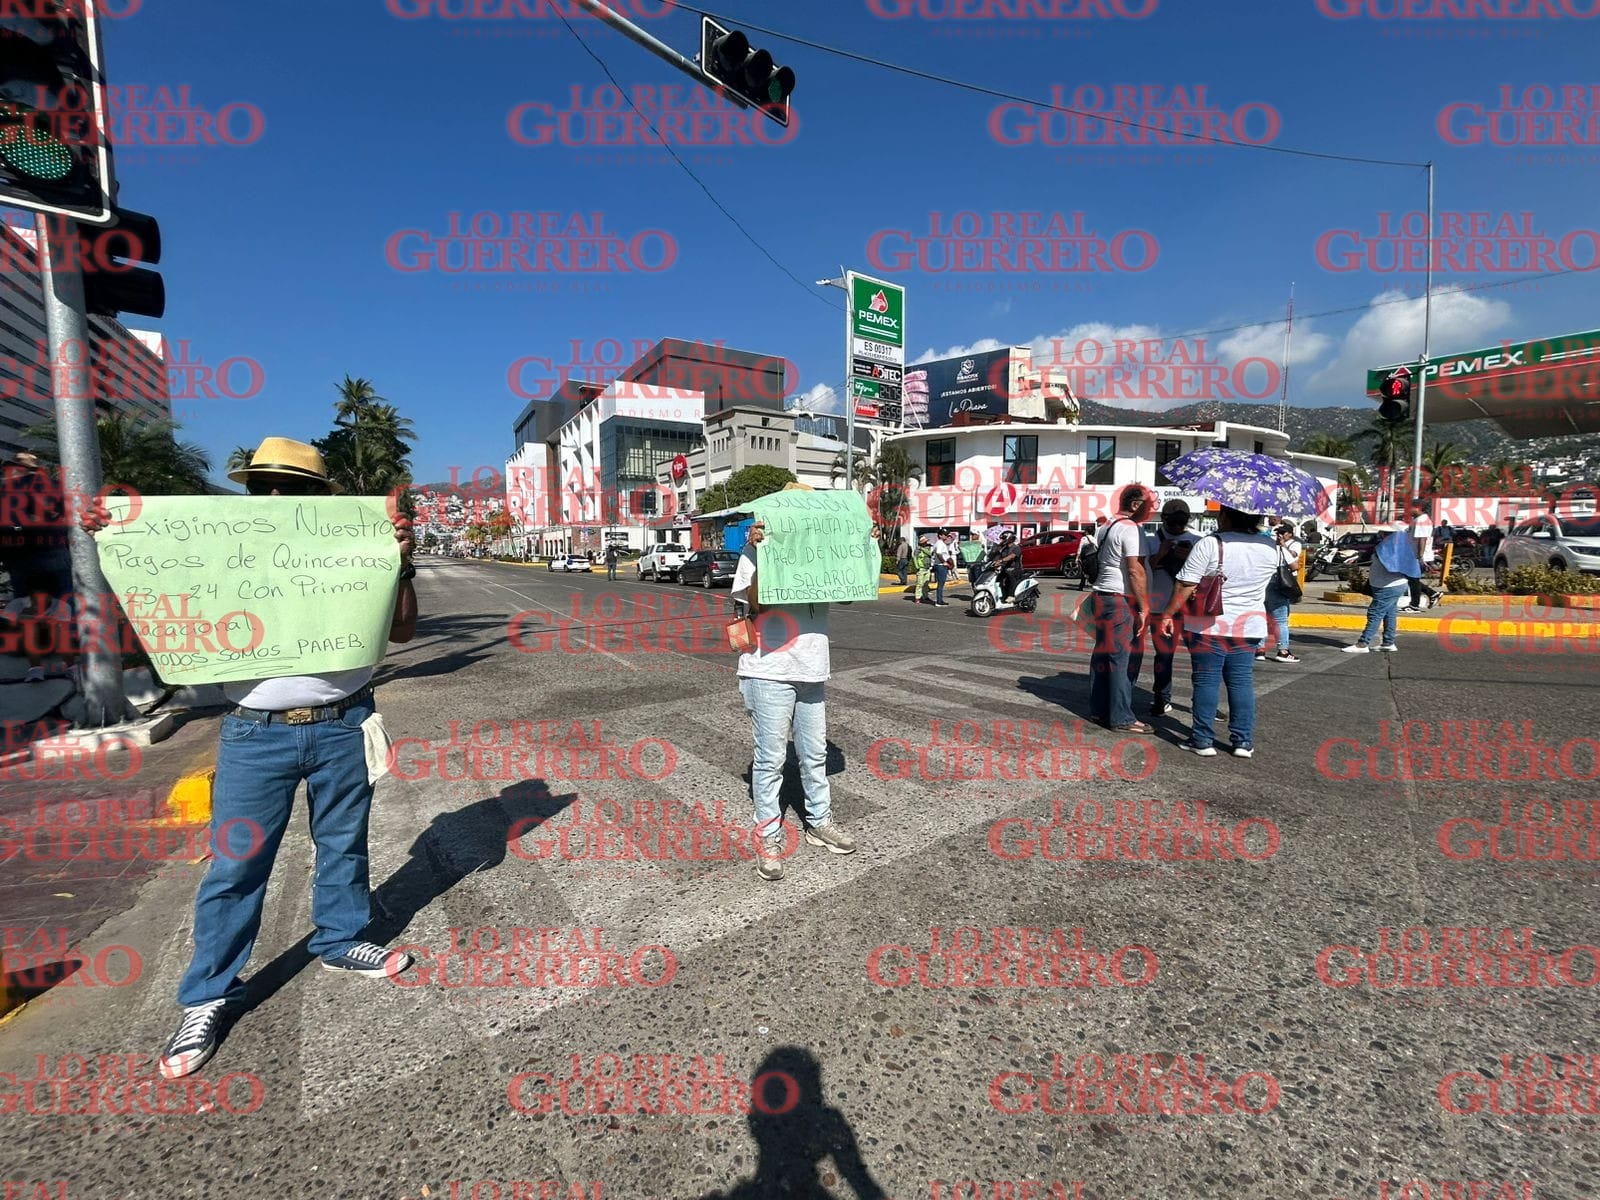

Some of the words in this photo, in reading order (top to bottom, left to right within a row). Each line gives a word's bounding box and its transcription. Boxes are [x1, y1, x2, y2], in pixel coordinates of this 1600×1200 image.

[858, 309, 899, 329] PEMEX
[864, 341, 874, 352] ES
[1021, 495, 1059, 506] Ahorro
[104, 544, 205, 575] Pagos
[226, 543, 256, 569] de
[273, 543, 393, 571] Quincenas
[762, 544, 798, 566] PAGO
[805, 545, 826, 564] DE
[290, 575, 368, 597] Prima
